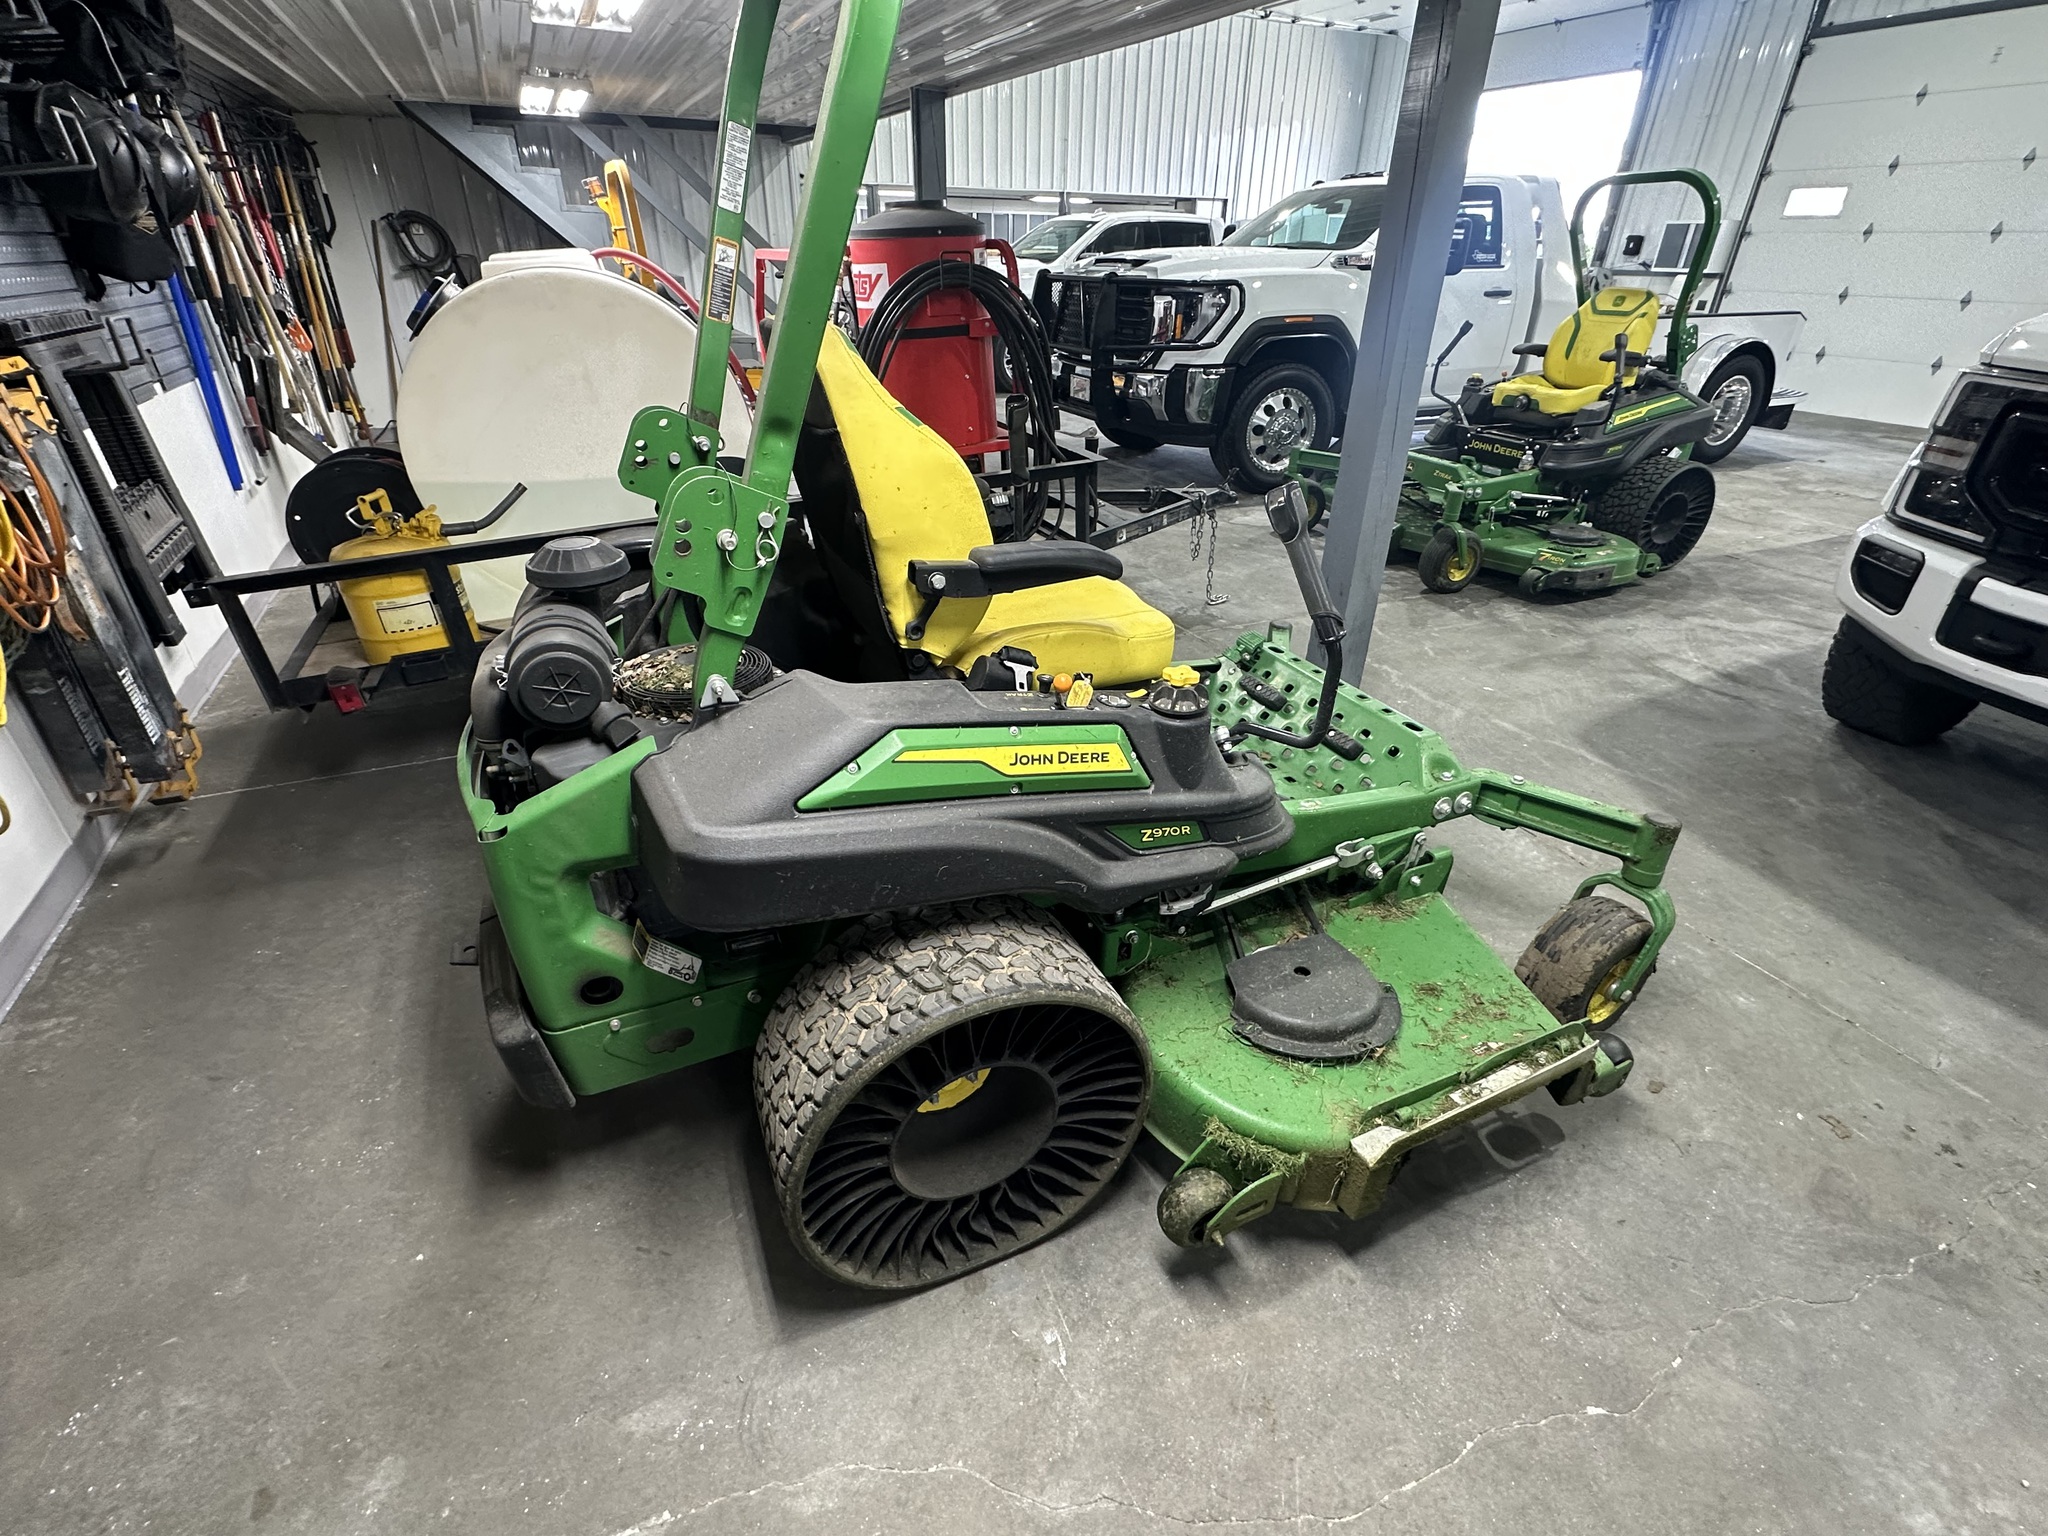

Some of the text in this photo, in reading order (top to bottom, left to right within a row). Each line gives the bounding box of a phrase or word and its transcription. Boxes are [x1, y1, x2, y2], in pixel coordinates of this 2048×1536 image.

[1469, 439, 1524, 459] JOHN DEERE
[1009, 751, 1110, 766] JOHN DEERE
[1141, 826, 1191, 842] Z970R
